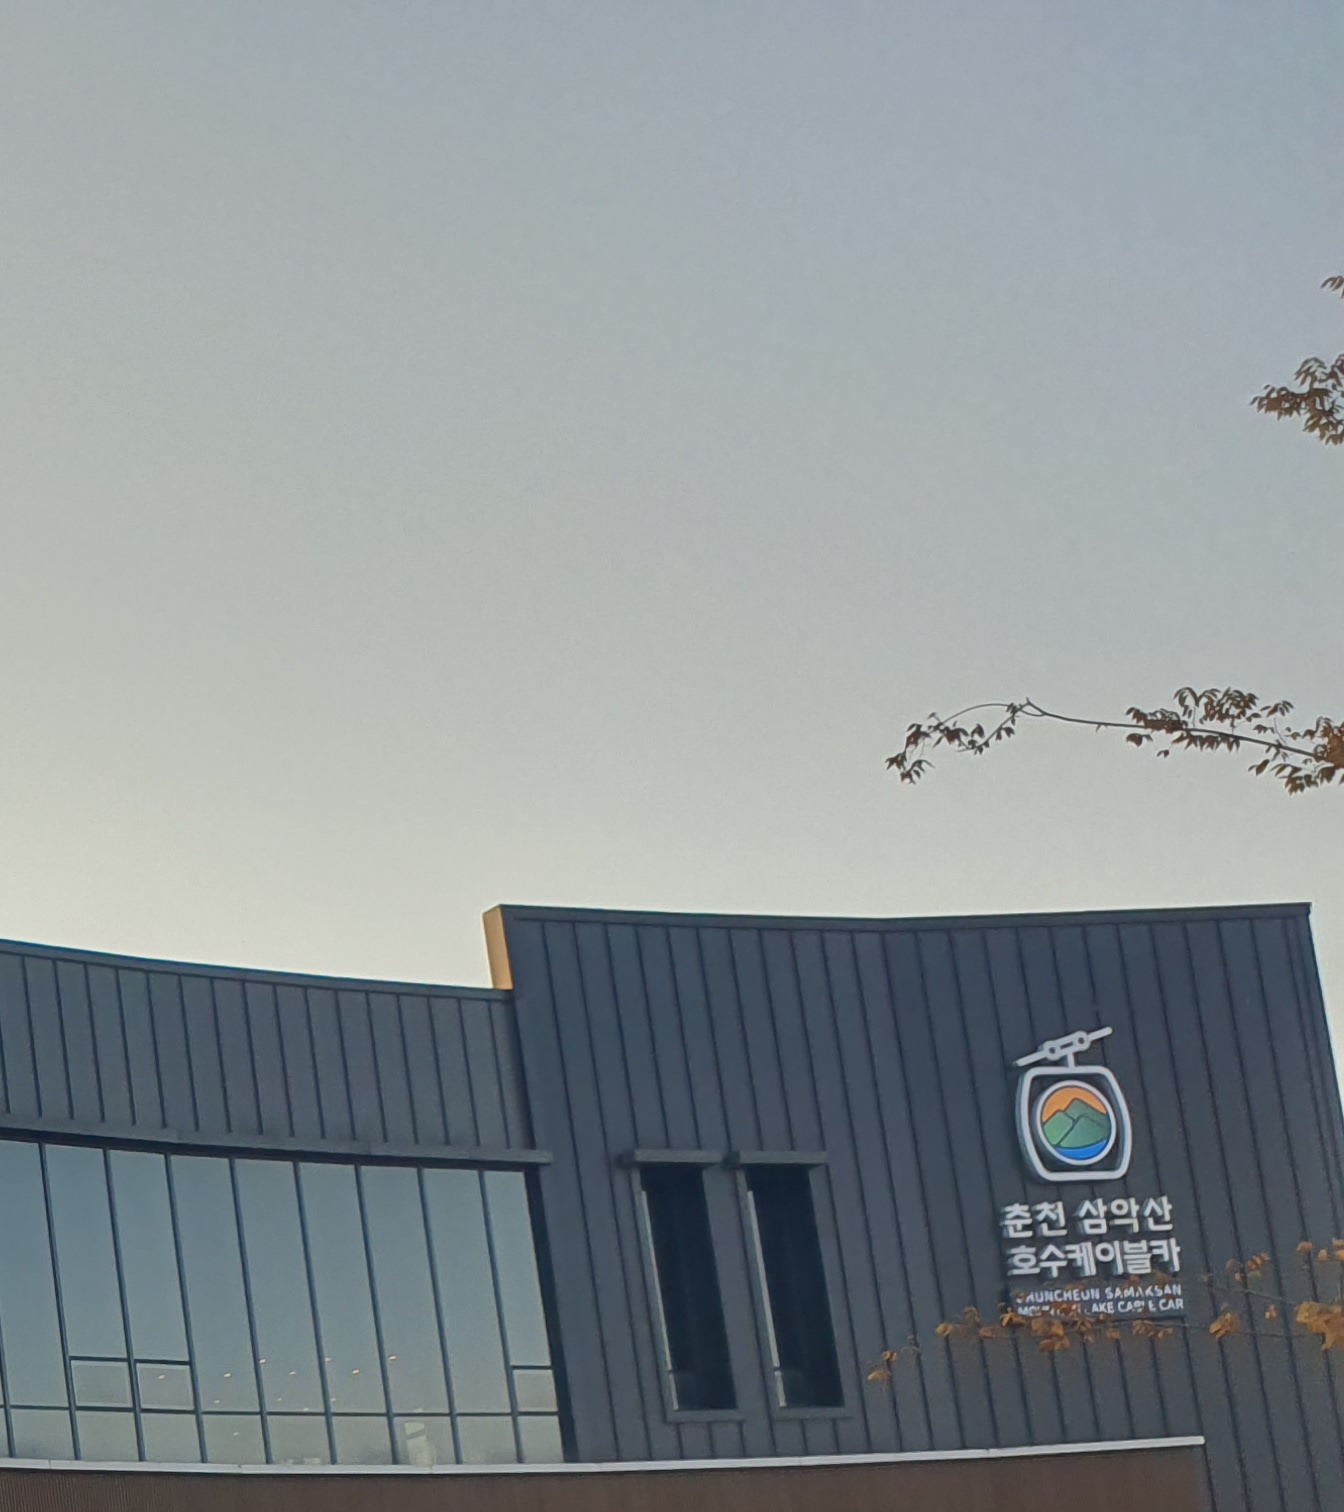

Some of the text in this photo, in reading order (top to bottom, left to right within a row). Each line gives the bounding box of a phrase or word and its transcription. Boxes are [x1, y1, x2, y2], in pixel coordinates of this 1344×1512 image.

[1000, 1195, 1174, 1239] 춘천 삼악산
[1007, 1237, 1182, 1279] 호수케이블카
[1159, 1298, 1185, 1310] CAR
